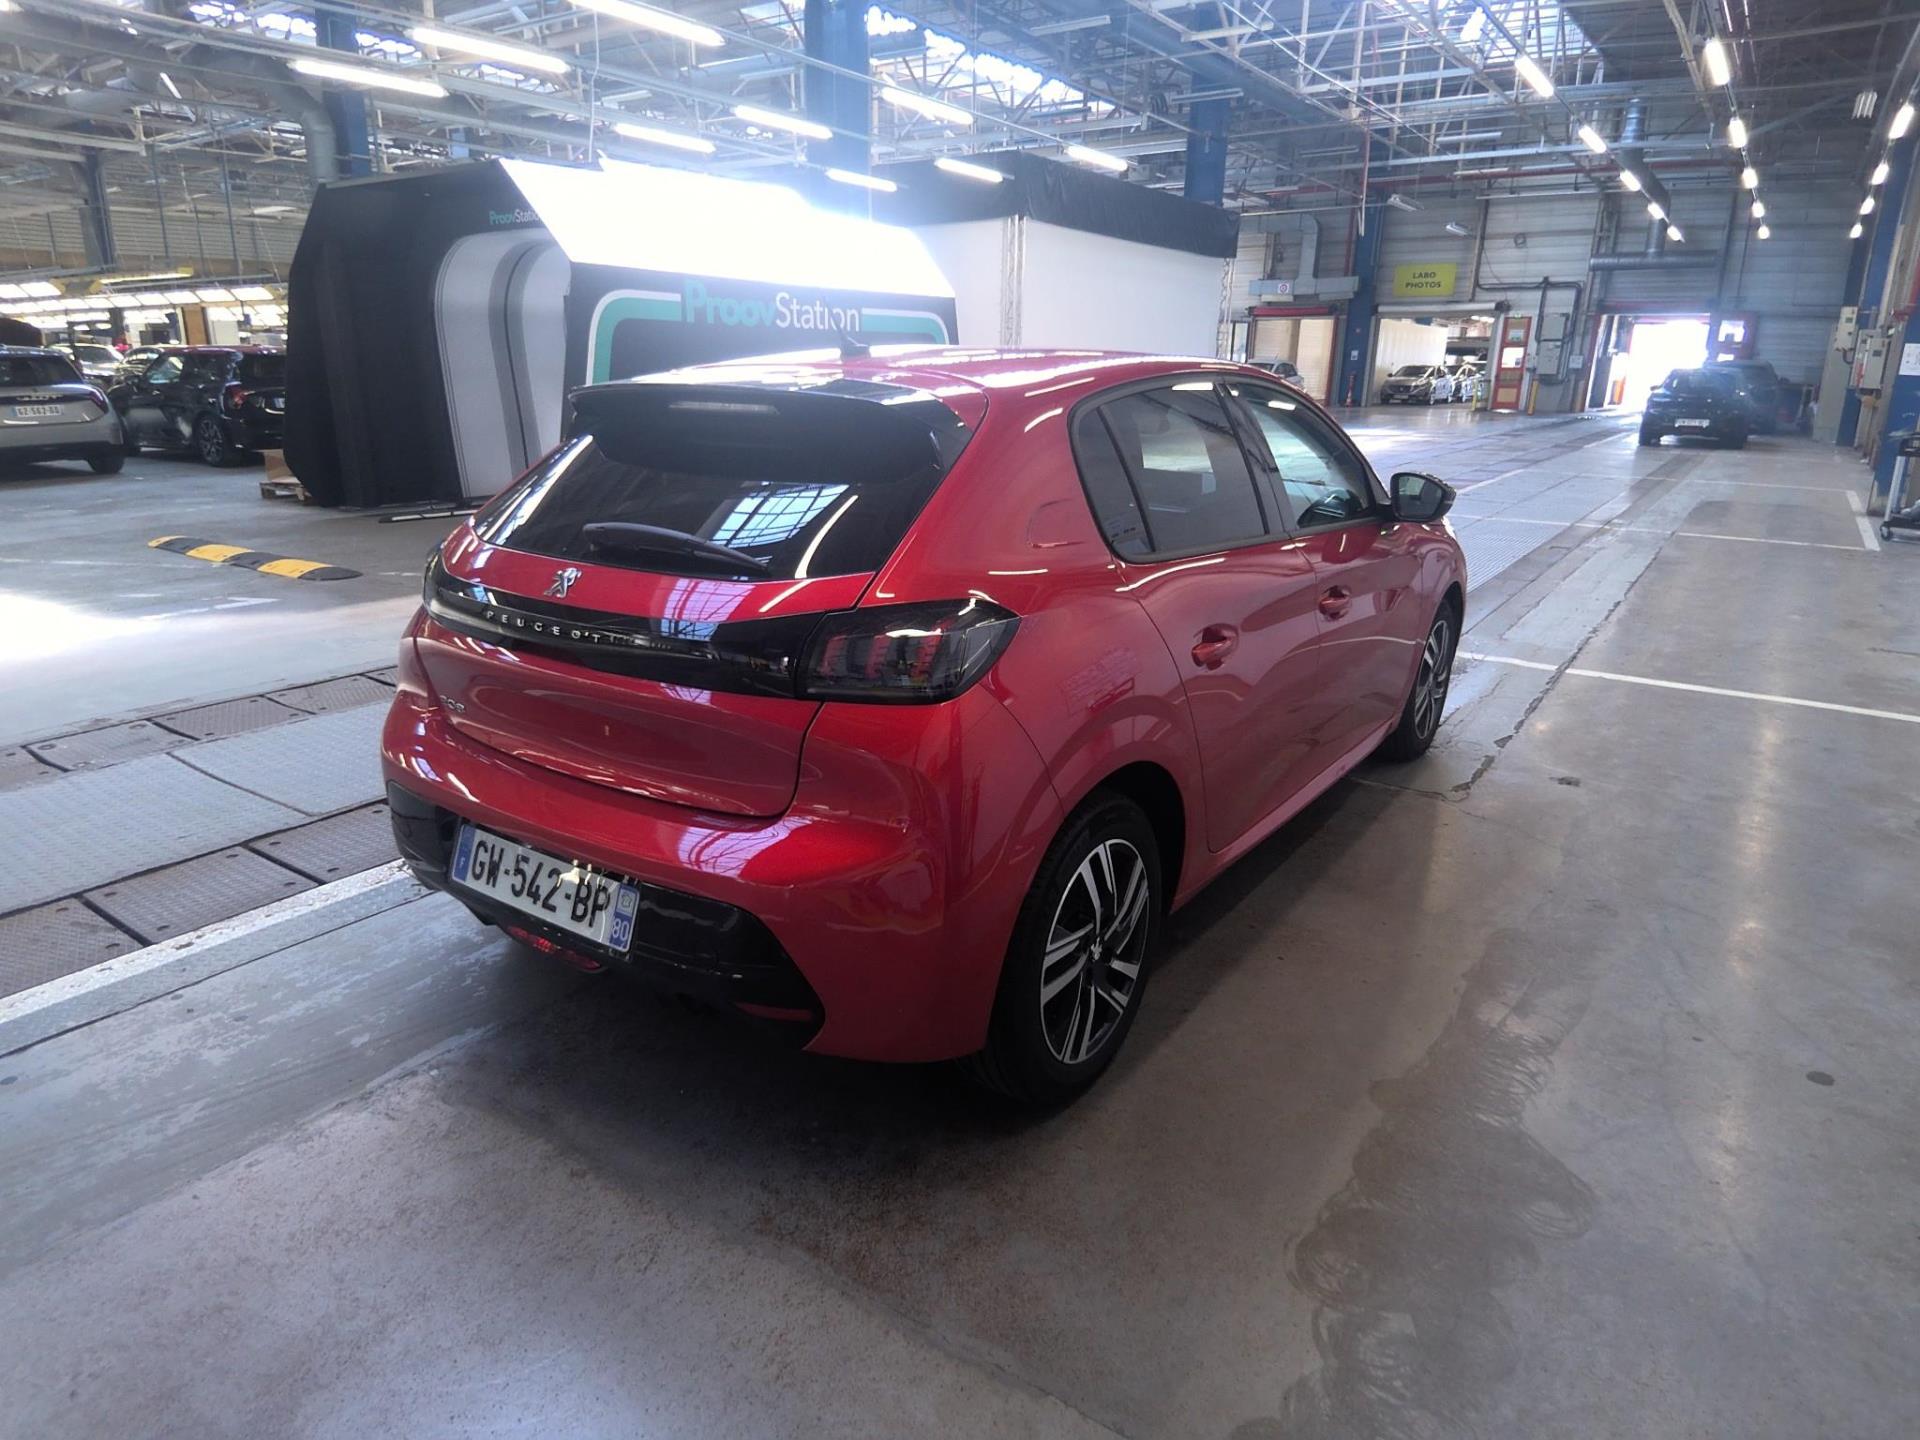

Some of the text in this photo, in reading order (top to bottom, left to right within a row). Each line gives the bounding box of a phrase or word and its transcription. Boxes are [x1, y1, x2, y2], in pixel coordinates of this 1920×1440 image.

[1405, 281, 1442, 289] PHOTOS
[1412, 271, 1437, 280] LABO
[685, 279, 860, 332] ProovStation
[486, 610, 601, 643] PEUGEOT
[471, 840, 611, 929] GW-542-BP
[612, 918, 630, 941] 80
